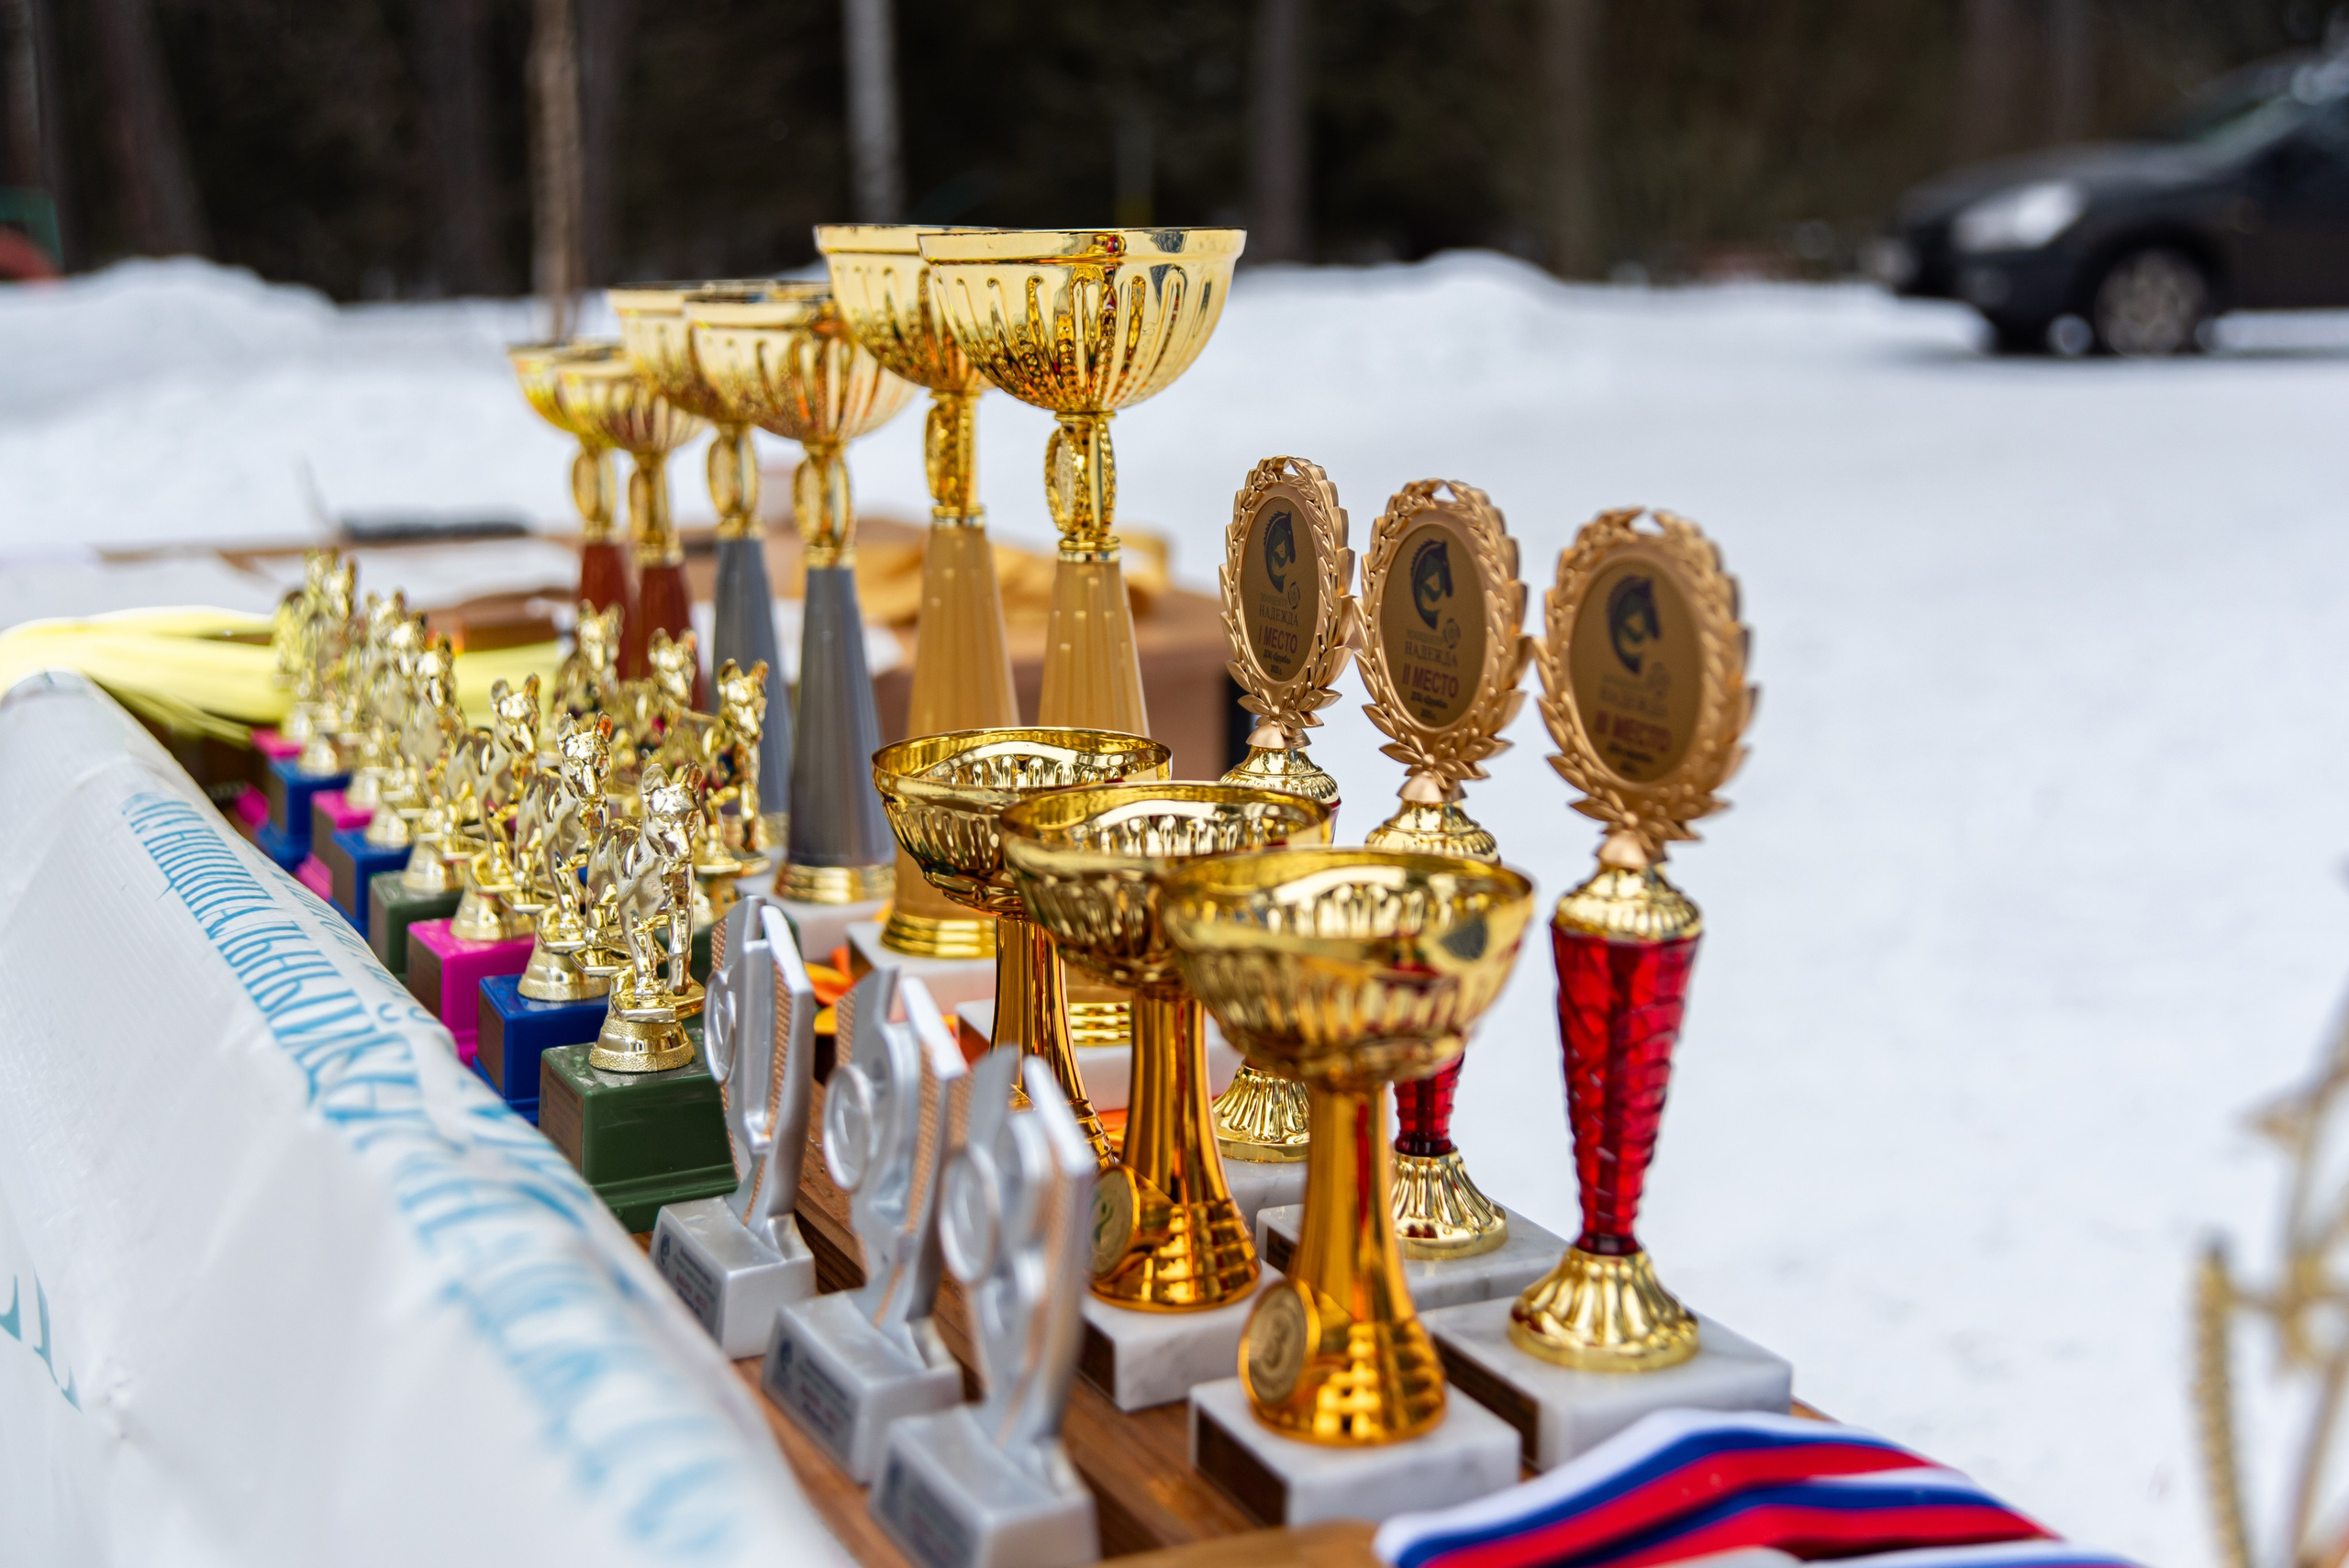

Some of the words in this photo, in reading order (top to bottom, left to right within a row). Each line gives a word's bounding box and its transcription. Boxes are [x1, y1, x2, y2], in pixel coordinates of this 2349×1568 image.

[1259, 604, 1299, 627] НАДЕЖДА
[1264, 627, 1298, 655] МЕСТО
[1405, 640, 1459, 668] НАДЕЖДА
[1413, 665, 1460, 699] МЕСТО
